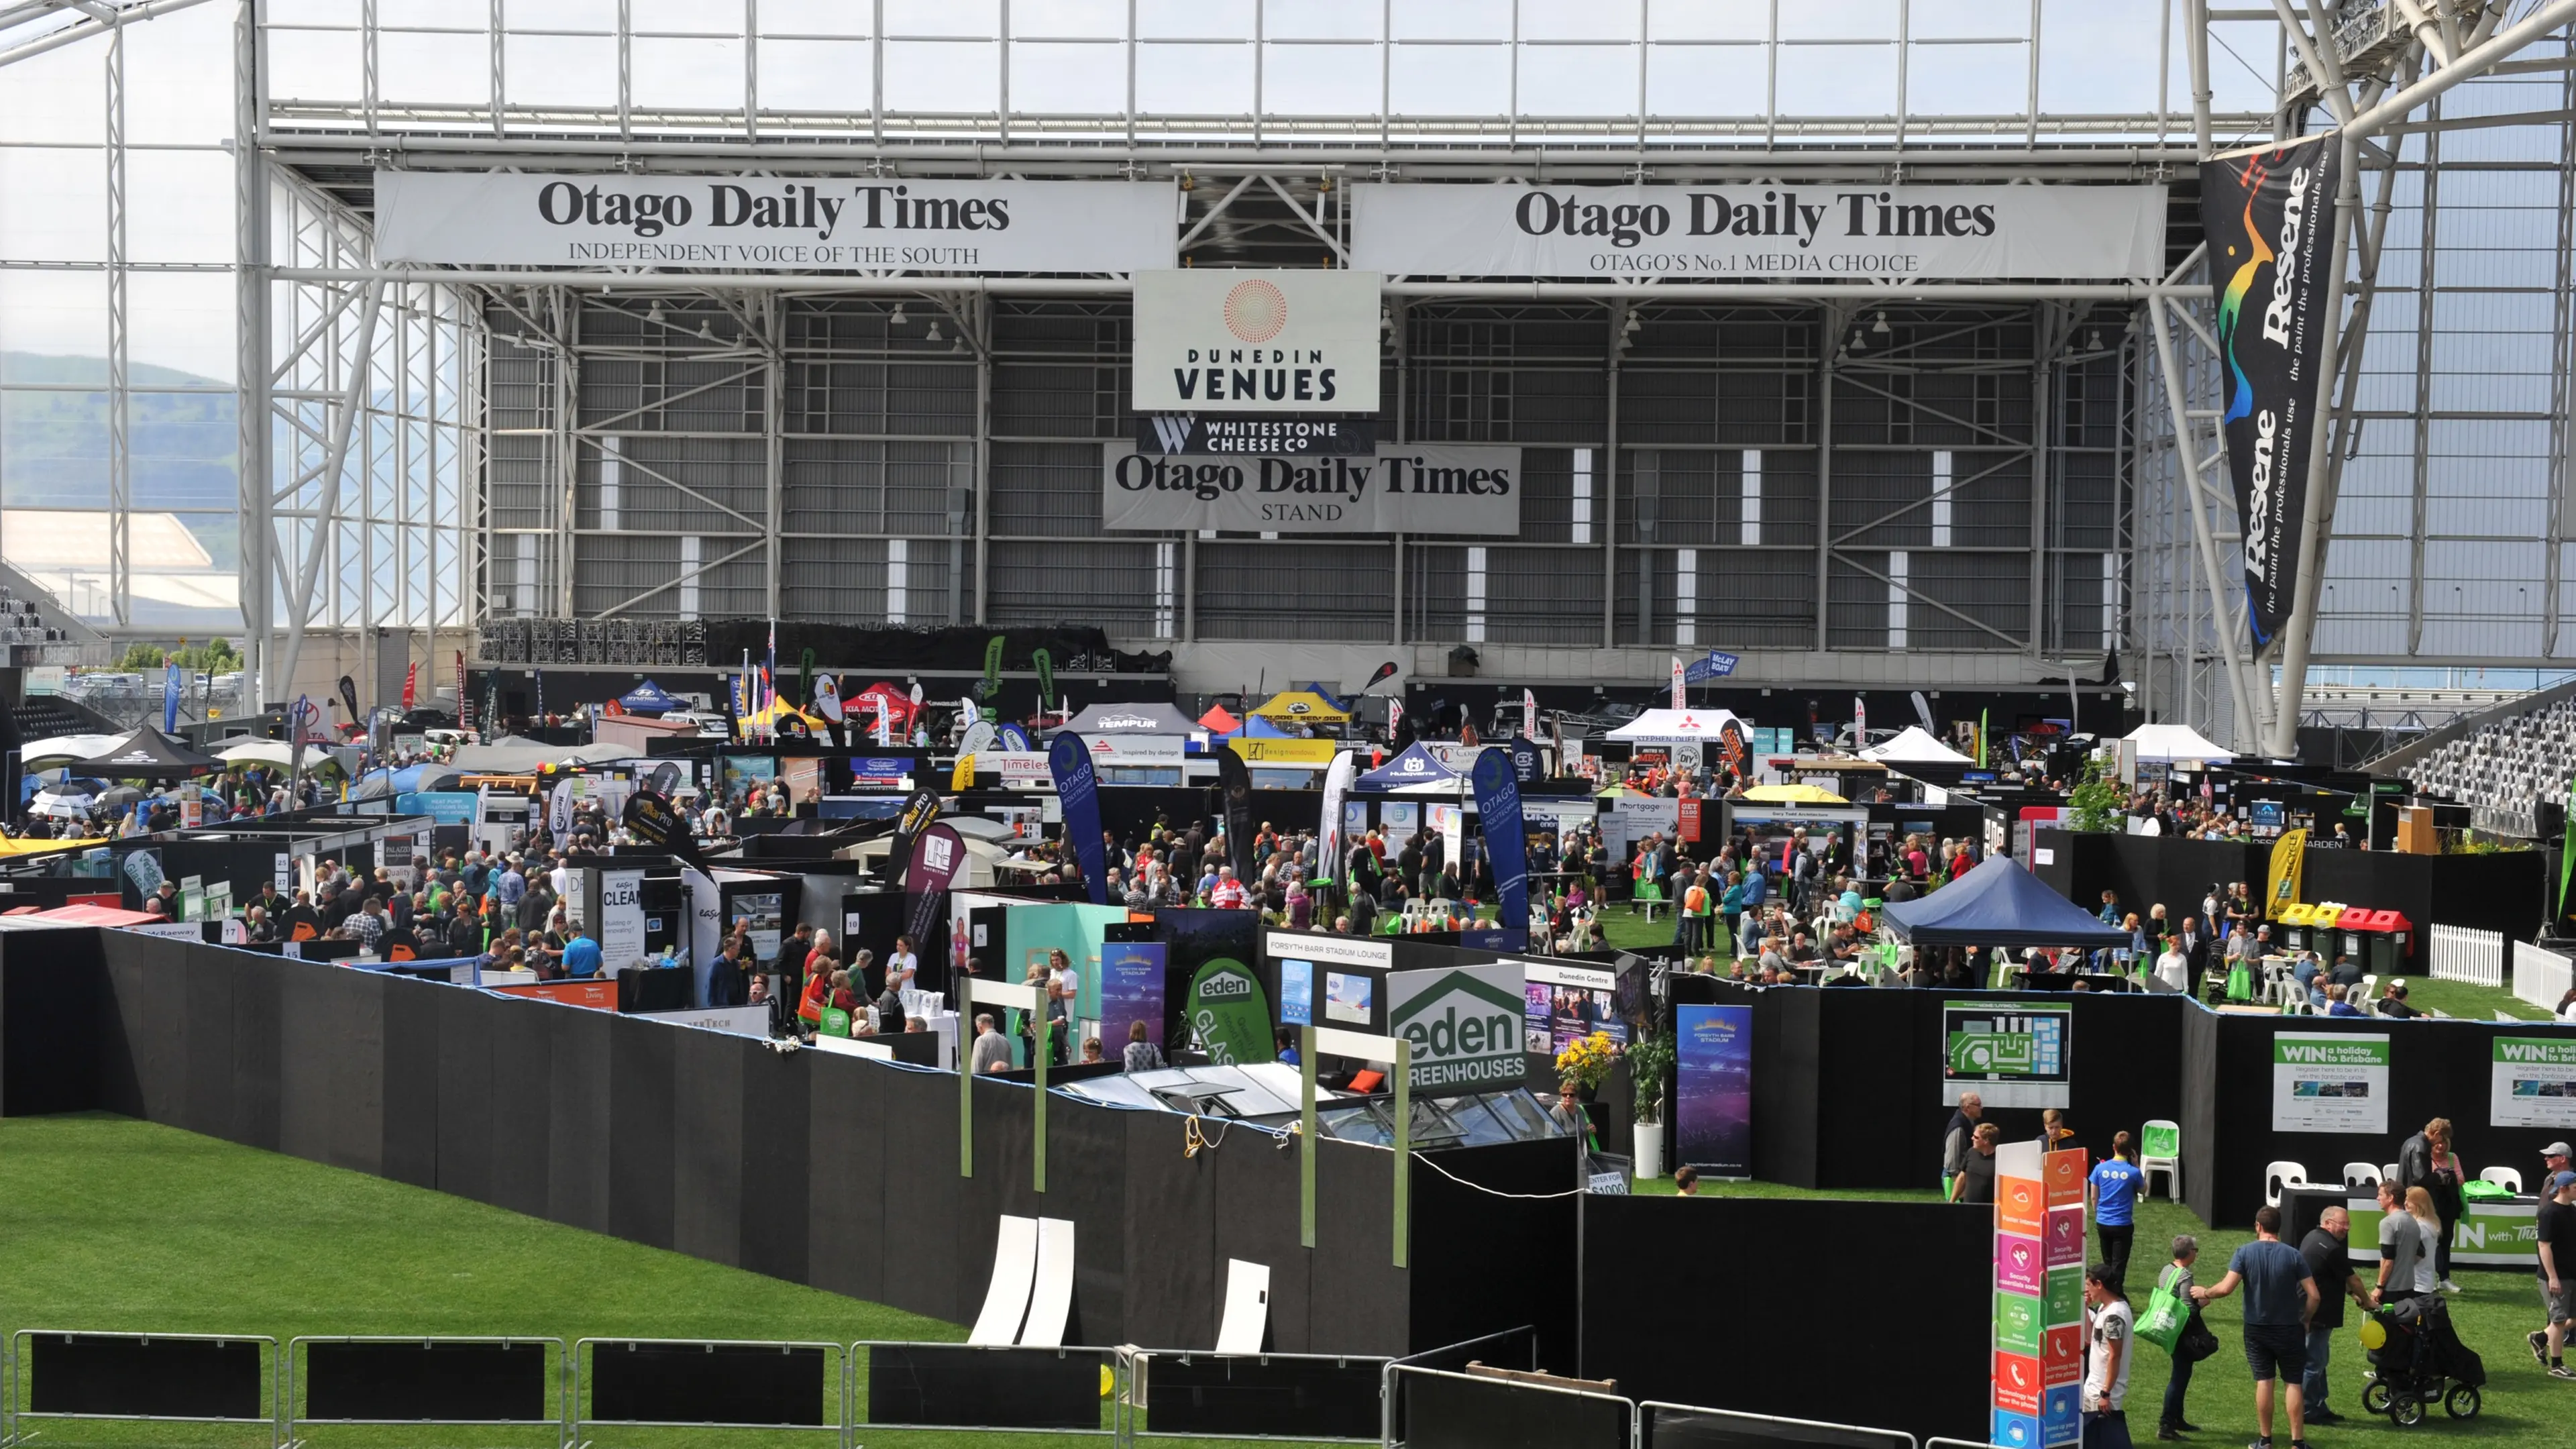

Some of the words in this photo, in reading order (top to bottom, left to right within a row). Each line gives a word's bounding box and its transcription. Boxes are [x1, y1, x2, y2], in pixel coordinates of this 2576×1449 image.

[2318, 150, 2328, 179] use
[539, 181, 692, 237] Otago
[708, 184, 845, 239] Daily
[855, 185, 1010, 230] Times
[1515, 191, 1670, 248] Otago
[1686, 192, 1827, 248] Daily
[1837, 192, 1996, 237] Times
[2302, 188, 2321, 284] professionals
[569, 242, 732, 261] INDEPENDENT
[738, 245, 808, 263] VOICE
[814, 246, 843, 263] OF
[849, 246, 896, 264] THE
[902, 246, 979, 264] SOUTH
[2263, 166, 2309, 350] Resene
[1590, 254, 1688, 272] OTAGO'S
[1694, 254, 1737, 272] No.1
[1744, 254, 1823, 272] MEDIA
[1829, 254, 1919, 272] CHOICE
[2298, 287, 2308, 312] the
[2294, 313, 2305, 354] paint
[1189, 349, 1323, 364] DUNEDIN
[2290, 358, 2300, 381] the
[1174, 368, 1336, 401] VENUES
[2286, 398, 2295, 423] use
[1205, 422, 1338, 437] WHITESTONE
[1208, 437, 1282, 452] CHEESE
[1115, 455, 1244, 500] Otago
[1256, 457, 1372, 503] Daily
[1380, 456, 1509, 496] Times
[2273, 433, 2291, 523] professionals
[2245, 409, 2276, 582] Resene
[1261, 504, 1342, 522] STAND
[2271, 525, 2280, 549] the
[2270, 551, 2279, 587] paint
[2267, 590, 2275, 614] the
[1038, 655, 1051, 696] Kawasaki
[1099, 719, 1157, 728] TEMPUR
[1000, 759, 1049, 771] Timeles
[1680, 755, 1694, 764] DIY
[659, 772, 674, 794] Hooker
[1060, 763, 1091, 793] OTAGO
[1064, 776, 1094, 804] POLYTECHNIC
[1482, 782, 1515, 814] OTAGO
[555, 796, 566, 828] HeatCo
[1485, 800, 1519, 826] POLYTECHNIC
[1619, 802, 1674, 812] mortgageme
[386, 846, 411, 854] PALAZZO
[2286, 835, 2298, 877] RECYCLE
[386, 867, 411, 879] Quality
[616, 881, 633, 890] easy
[147, 928, 196, 937] McRaeway
[1271, 941, 1303, 951] FORSYTH
[1305, 945, 1324, 953] BARR
[1326, 947, 1355, 957] STADIUM
[1357, 950, 1387, 959] LOUNGE
[1202, 977, 1246, 995] eden
[1559, 972, 1585, 981] Dunedin
[1587, 975, 1608, 984] Centre
[586, 992, 604, 1001] Living
[1403, 1007, 1513, 1060] eden
[2282, 1045, 2326, 1063] WIN
[2327, 1054, 2338, 1062] to
[2341, 1055, 2383, 1063] Brisbane
[2337, 1046, 2372, 1056] holiday
[2501, 1044, 2547, 1061] WIN
[2558, 1045, 2576, 1054] holi
[1409, 1057, 1525, 1087] REENHOUSES
[1589, 1176, 1608, 1184] ENTER
[2488, 1230, 2512, 1242] with
[2047, 1254, 2066, 1262] ssentials
[2054, 1246, 2072, 1254] Security
[2009, 1272, 2031, 1283] Security
[2045, 1363, 2069, 1373] echnology
[1997, 1387, 2026, 1401] Technology
